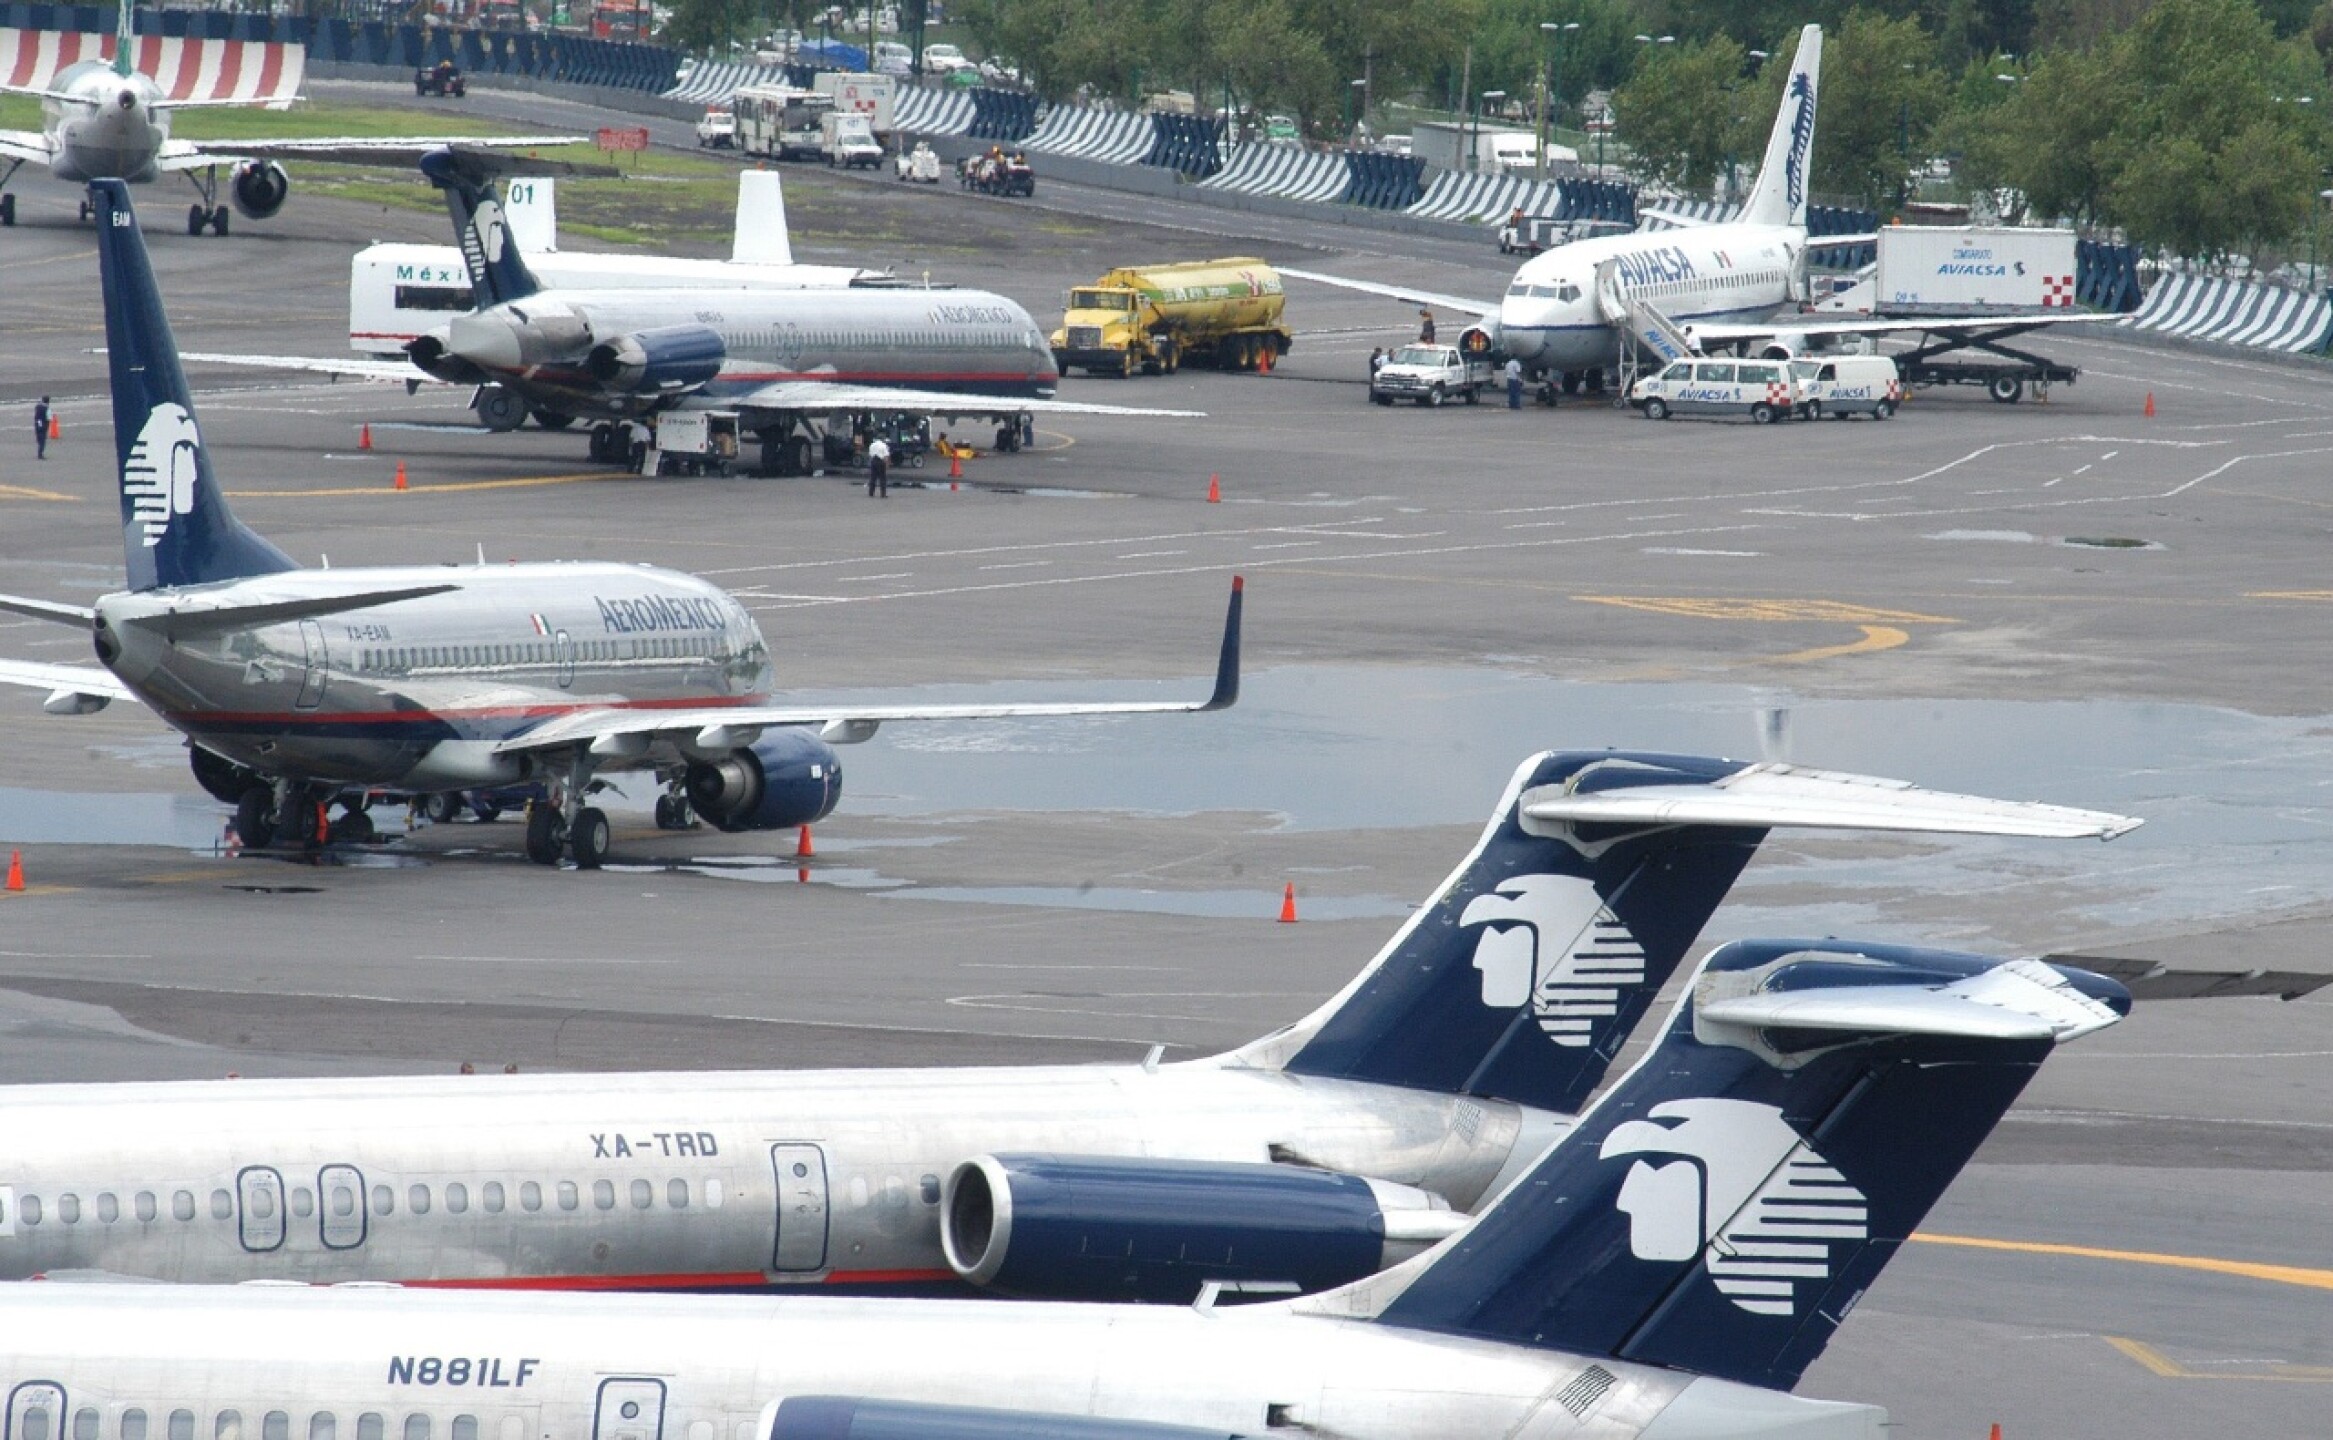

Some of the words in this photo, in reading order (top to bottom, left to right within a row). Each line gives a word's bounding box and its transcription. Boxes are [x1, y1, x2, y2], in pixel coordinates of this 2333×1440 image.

[511, 184, 534, 204] 01
[396, 265, 462, 281] Méxi
[1613, 246, 1696, 287] AVIACSA
[1937, 263, 2006, 276] AVIACSA
[1677, 387, 1731, 400] AVIACSA
[589, 1131, 719, 1158] XA-TRD
[387, 1355, 541, 1388] N881LF
